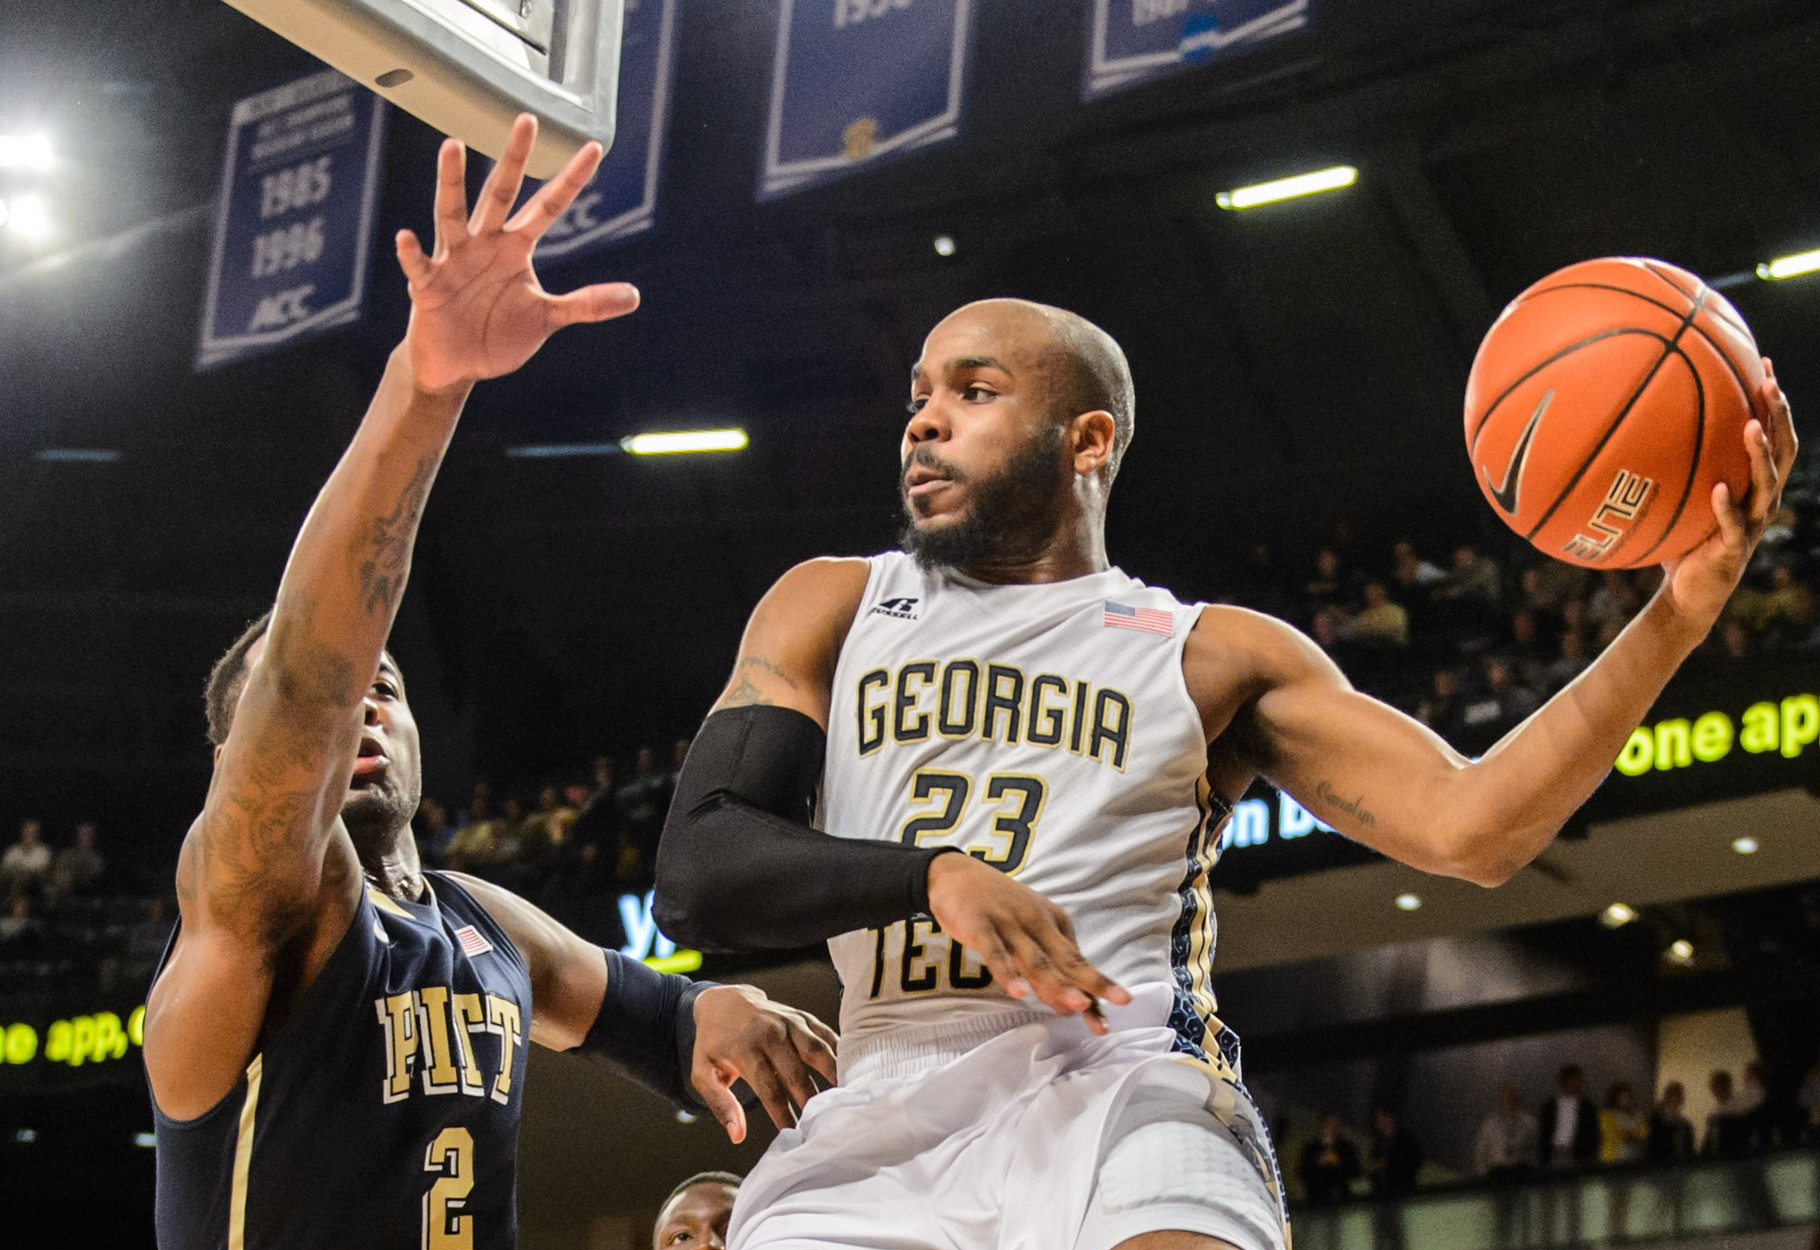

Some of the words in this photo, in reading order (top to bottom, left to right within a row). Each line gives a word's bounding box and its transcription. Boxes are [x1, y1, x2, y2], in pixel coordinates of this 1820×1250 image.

[261, 154, 332, 219] 1985
[249, 283, 317, 334] ACC
[1561, 468, 1654, 561] ELITE
[854, 656, 1135, 775] GEORGIA
[899, 767, 1051, 878] 23
[866, 914, 996, 1004] TEC
[375, 986, 523, 1105] PITT
